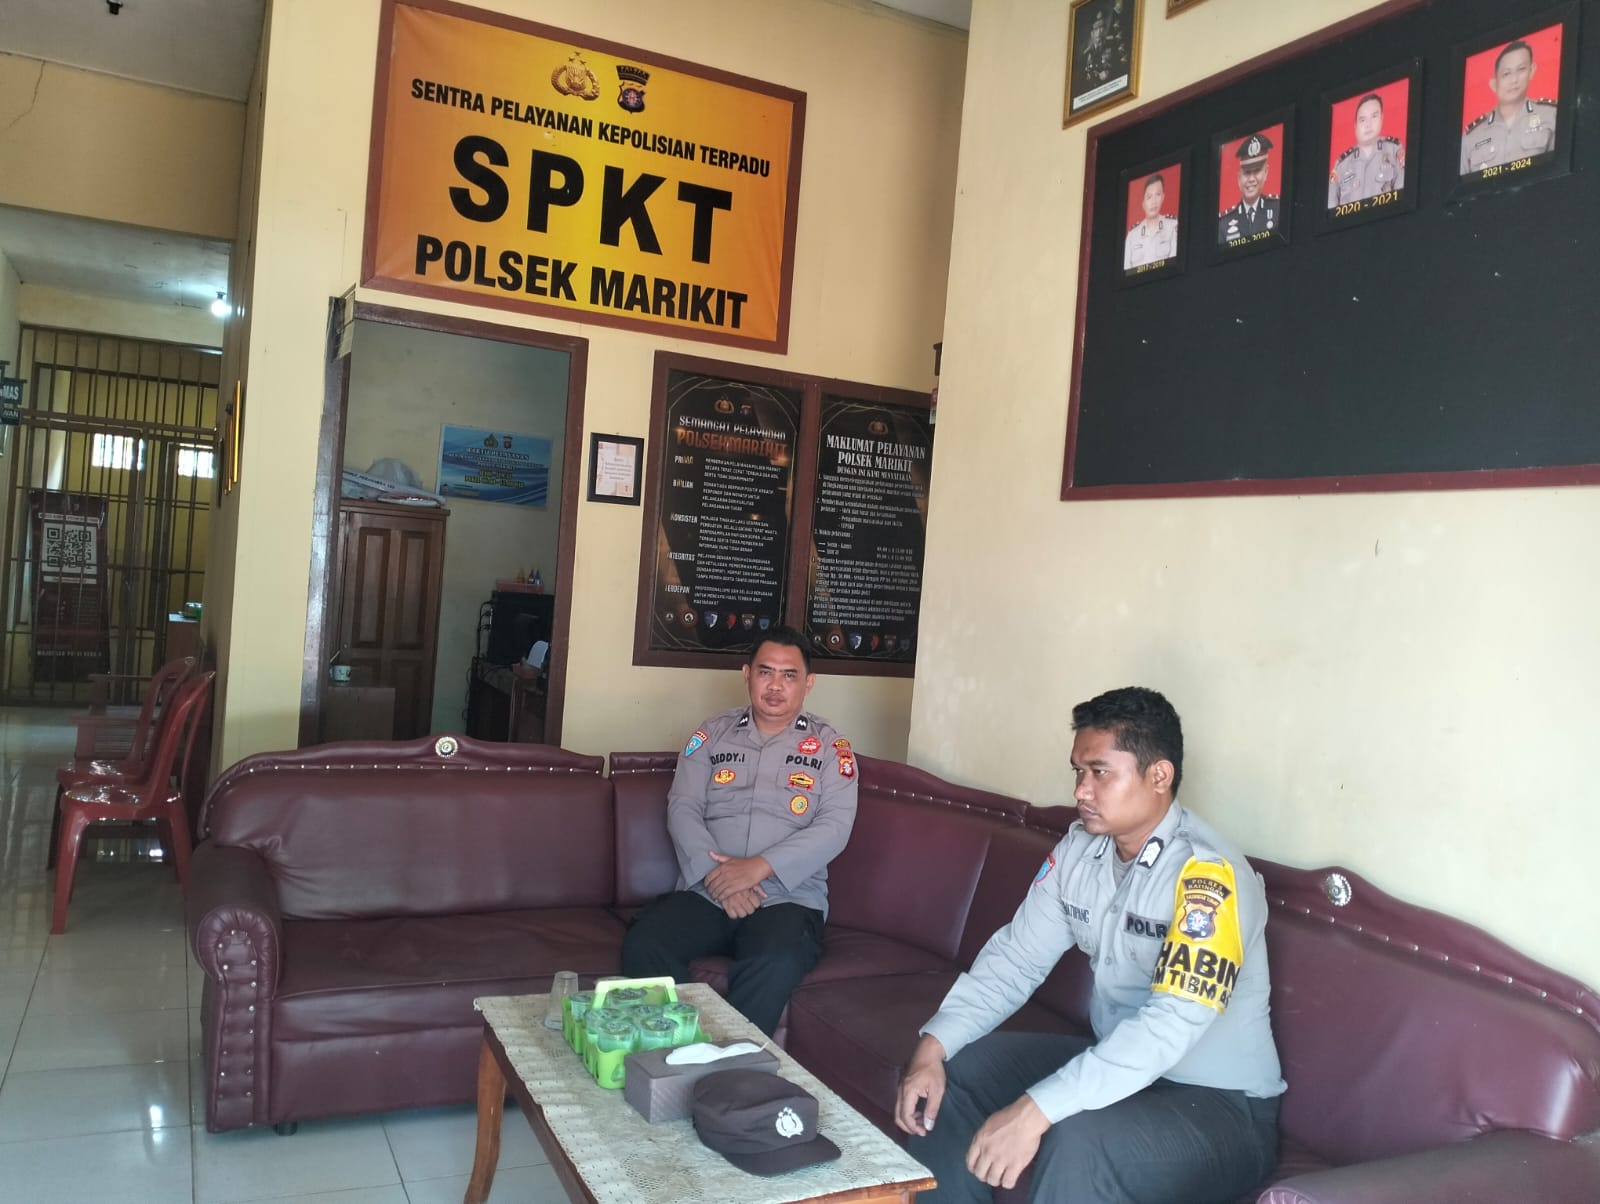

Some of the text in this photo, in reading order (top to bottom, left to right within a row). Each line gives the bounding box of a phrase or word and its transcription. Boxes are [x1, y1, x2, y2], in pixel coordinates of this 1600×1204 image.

[411, 78, 770, 178] SENTRA PELAYANAN KEPOLISIAN TERPADU
[1510, 157, 1531, 171] 2024
[449, 135, 732, 264] SPKT
[1336, 201, 1360, 217] 2020
[1372, 191, 1398, 207] 2021
[415, 234, 748, 329] POLSEK MARIKIT
[826, 434, 926, 459] MAKLUMAT PELAYANAN
[838, 451, 913, 472] POLSEK MARIKIT
[710, 752, 745, 765] DEDDY.I
[785, 754, 822, 770] POLRI
[1191, 879, 1223, 890] POLRES
[1126, 915, 1171, 938] POLR
